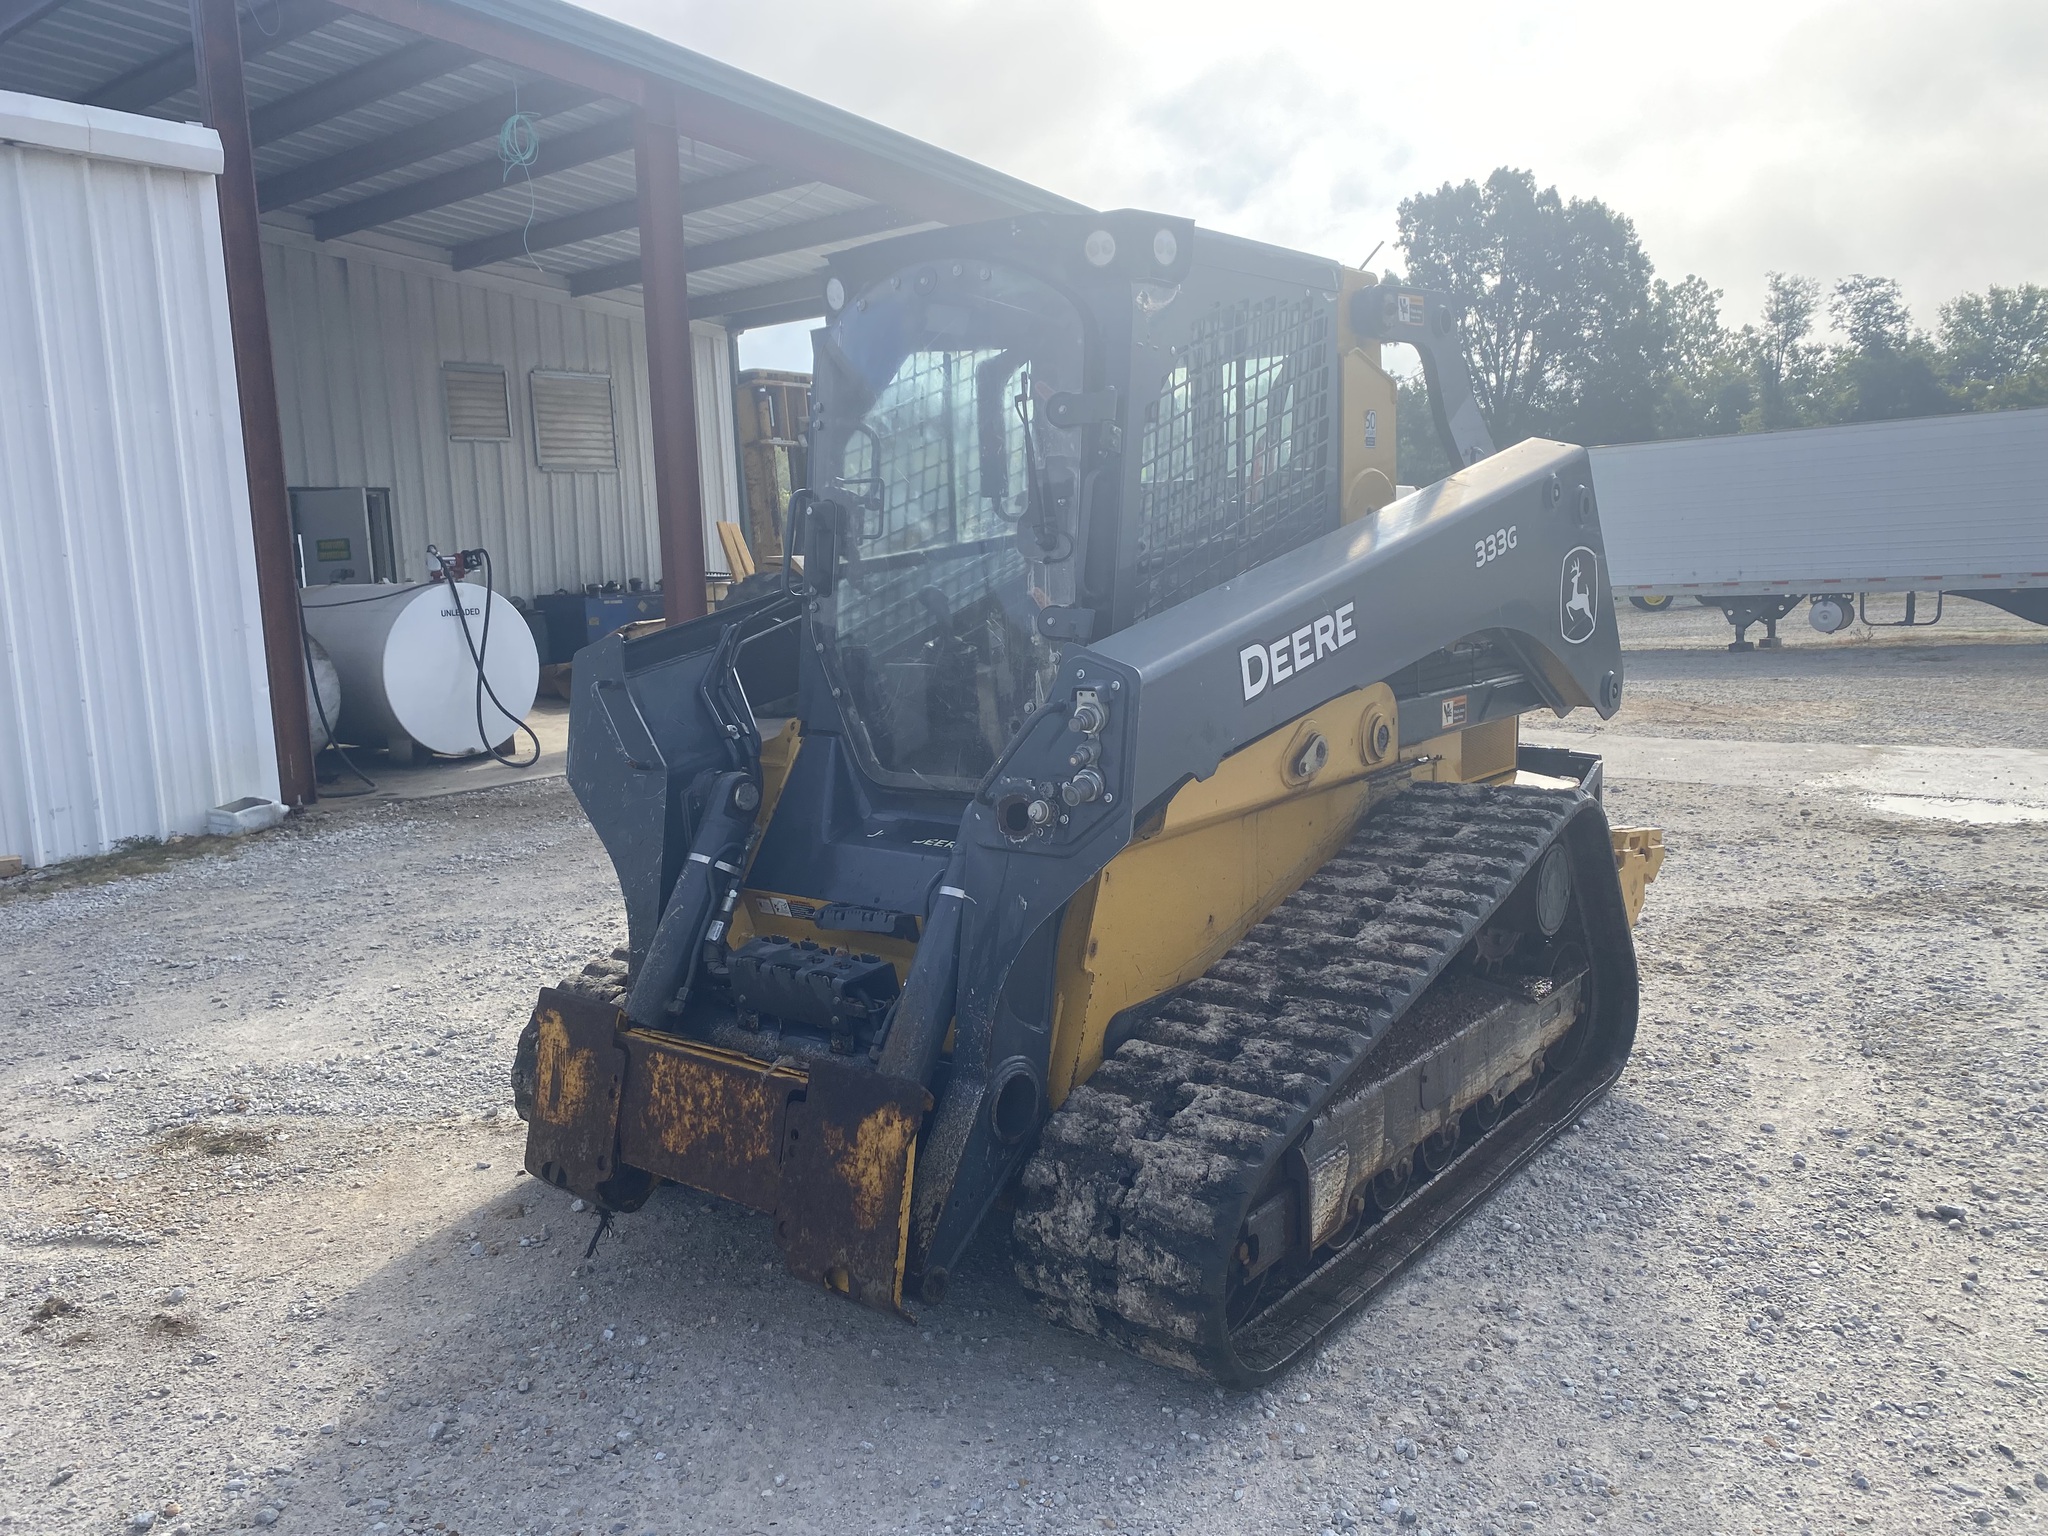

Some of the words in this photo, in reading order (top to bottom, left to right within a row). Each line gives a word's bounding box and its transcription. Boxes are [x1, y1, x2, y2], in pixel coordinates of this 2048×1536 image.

[1474, 525, 1518, 568] 333G
[440, 608, 480, 617] UNLEDED
[1239, 601, 1357, 701] DEERE
